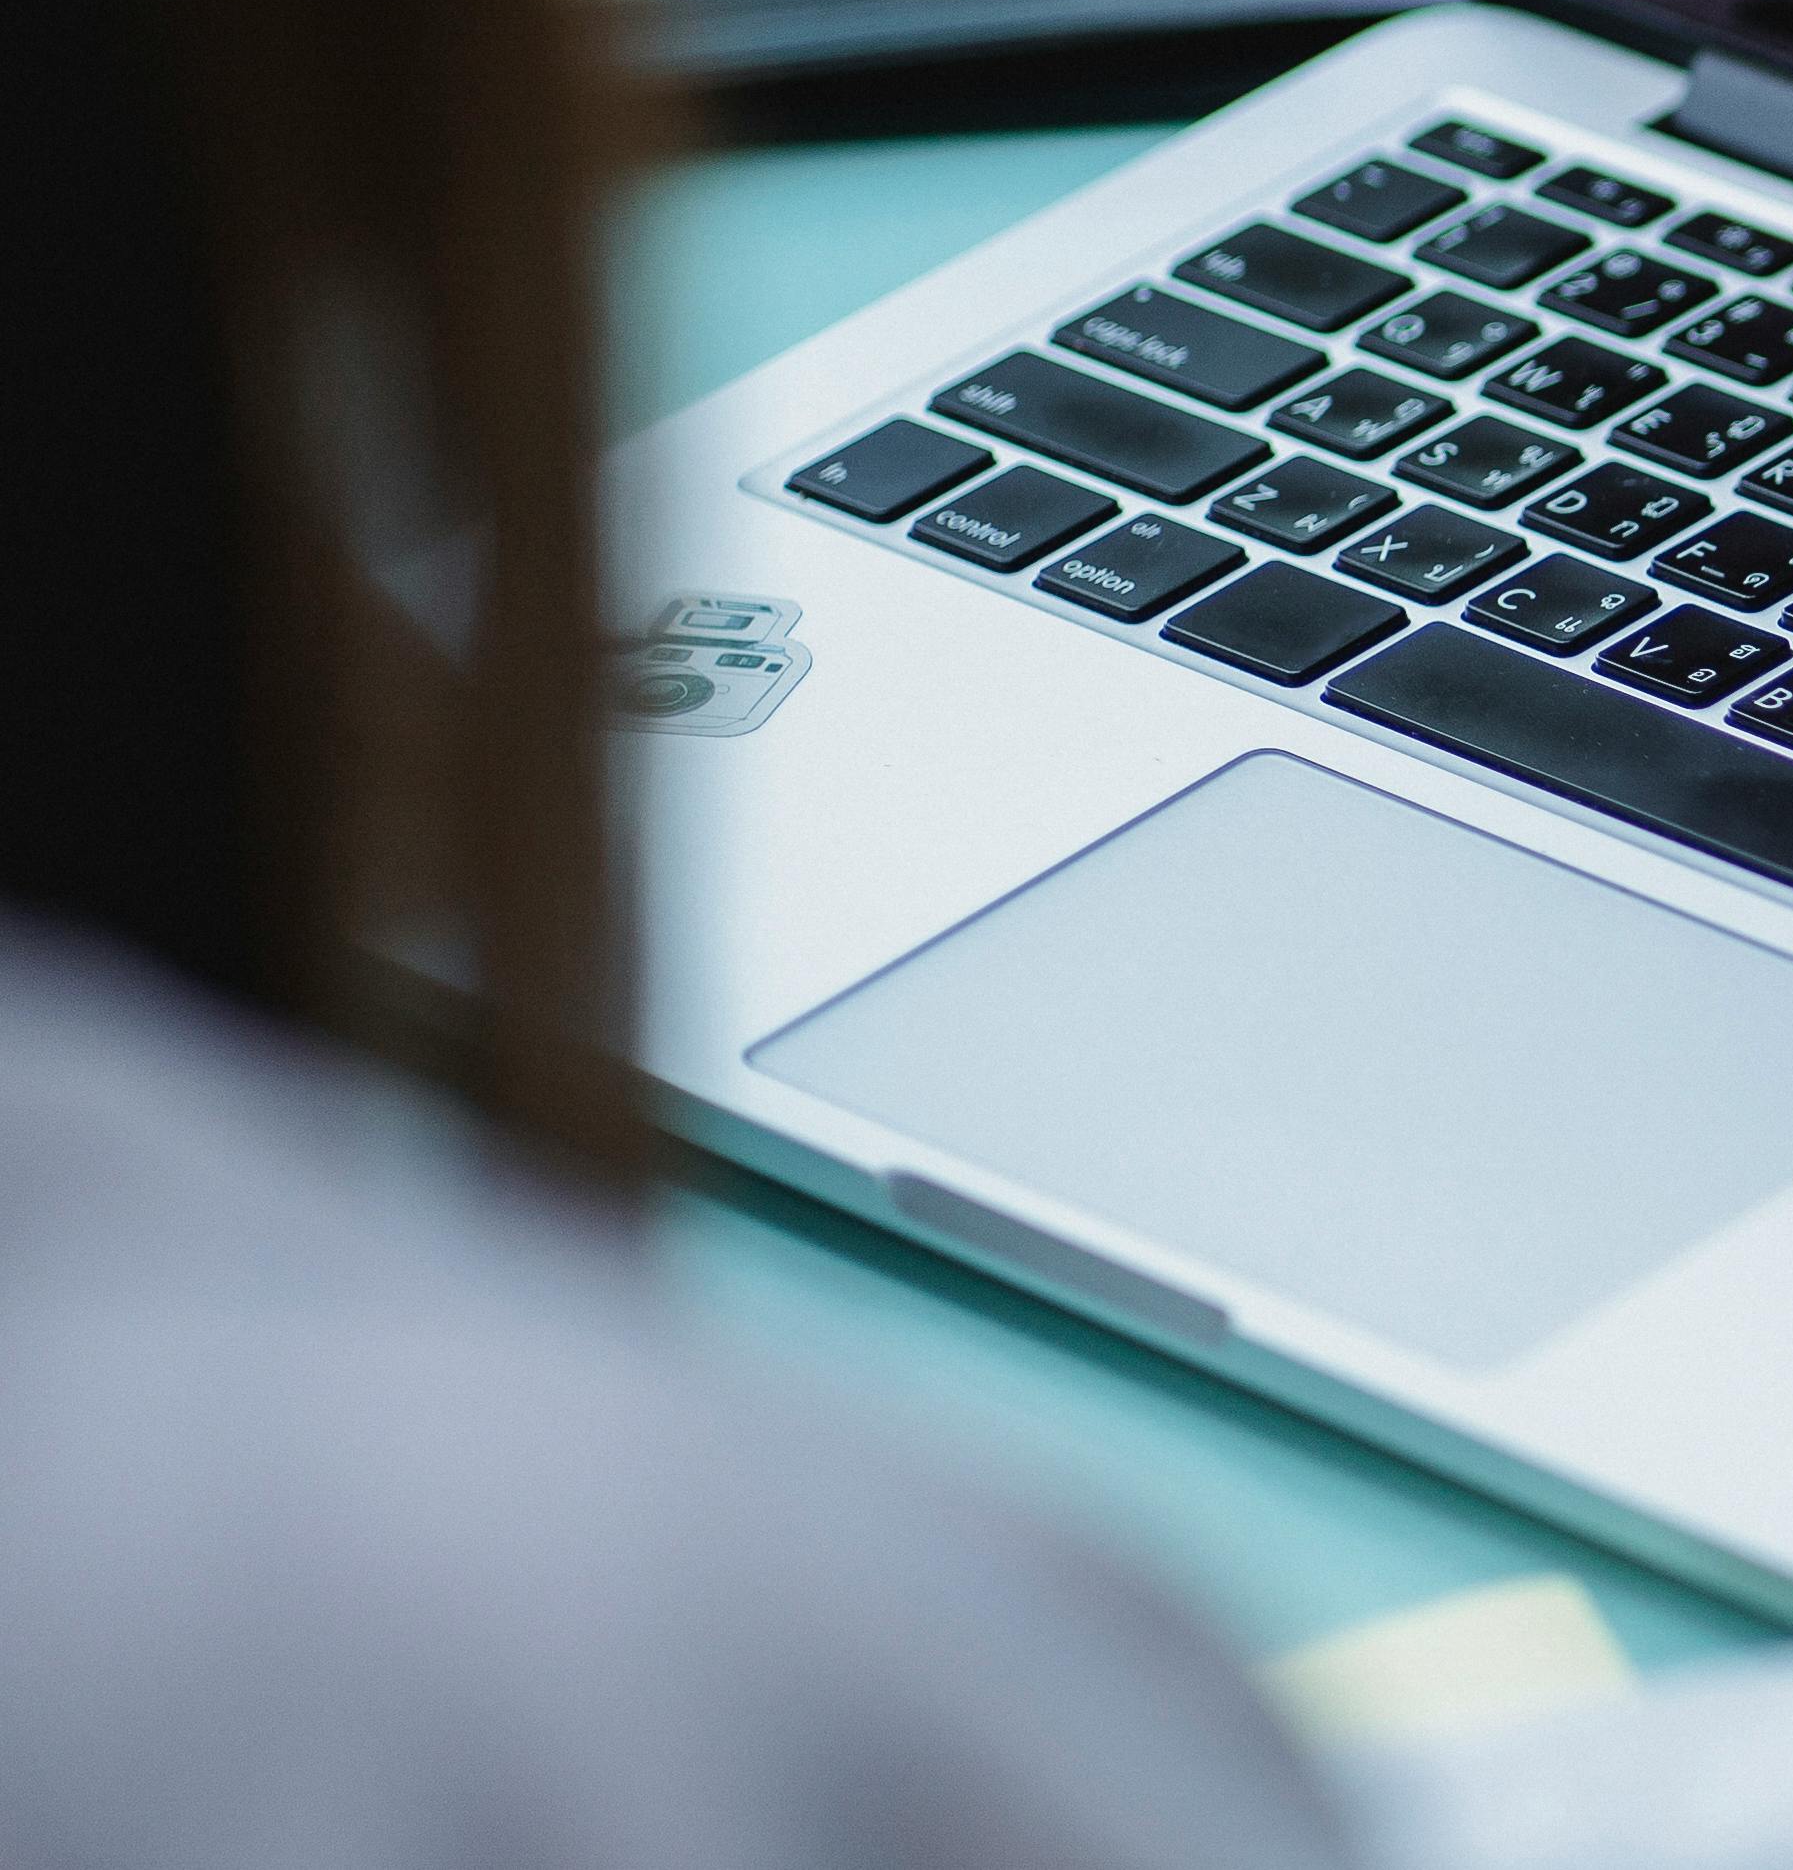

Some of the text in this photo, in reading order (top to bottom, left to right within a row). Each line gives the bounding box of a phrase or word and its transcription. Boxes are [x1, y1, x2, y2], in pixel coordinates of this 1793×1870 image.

[1509, 360, 1561, 392] W
[1292, 395, 1331, 422] A
[1630, 407, 1670, 434] E
[1418, 442, 1458, 466] S
[1232, 483, 1278, 511] Z
[1546, 490, 1584, 514] D
[935, 510, 1021, 548] control
[1360, 534, 1408, 562] X
[1676, 540, 1717, 559] F
[1062, 560, 1135, 595] option
[1497, 588, 1537, 610] C
[1629, 636, 1669, 658] V
[1753, 687, 1793, 710] B
